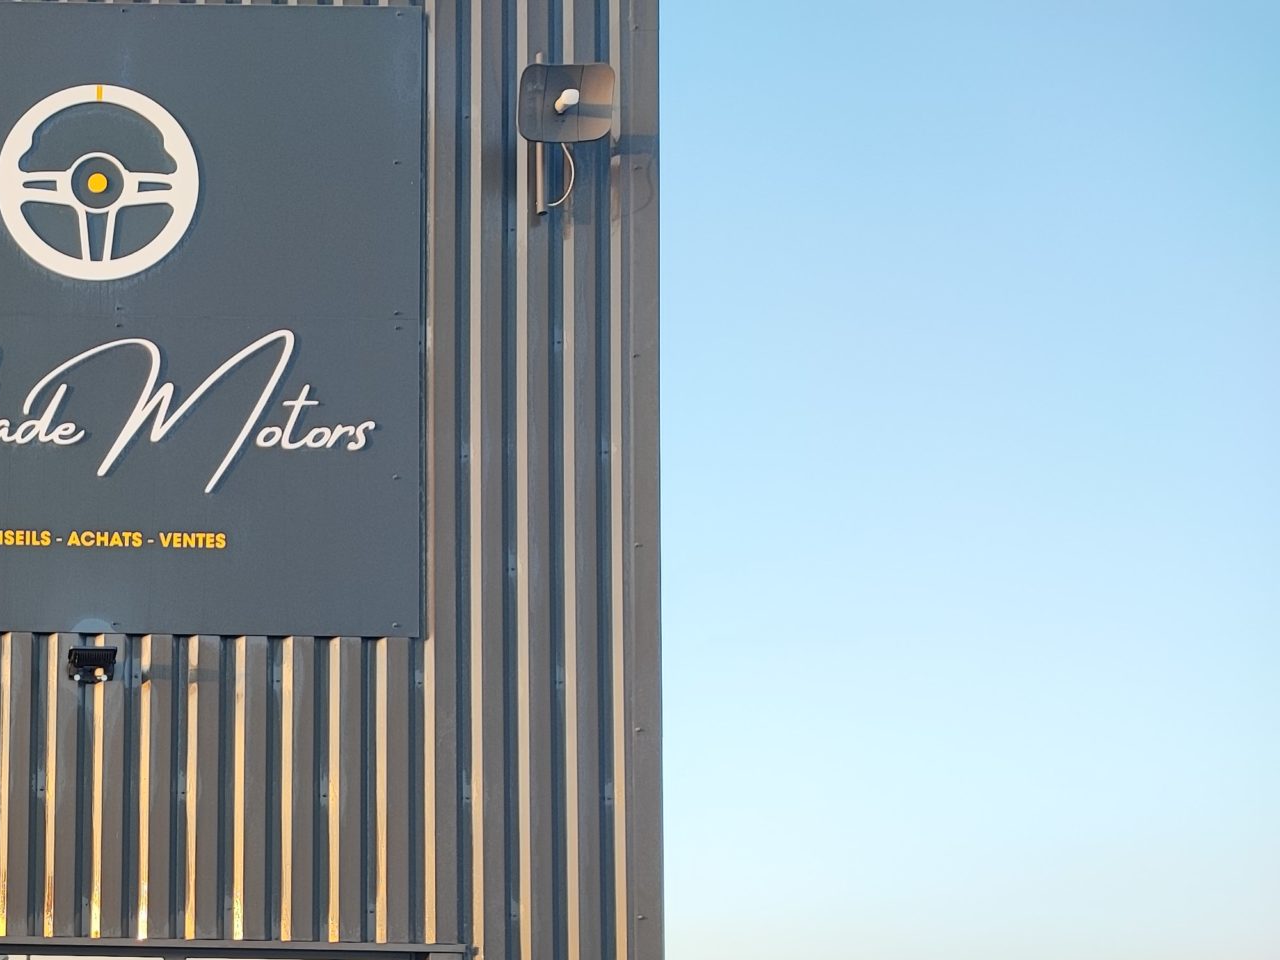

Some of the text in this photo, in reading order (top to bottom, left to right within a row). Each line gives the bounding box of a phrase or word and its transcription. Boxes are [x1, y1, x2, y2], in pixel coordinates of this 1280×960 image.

[22, 329, 377, 494] Motors
[67, 530, 143, 548] ACHATS
[159, 531, 227, 550] VENTES
